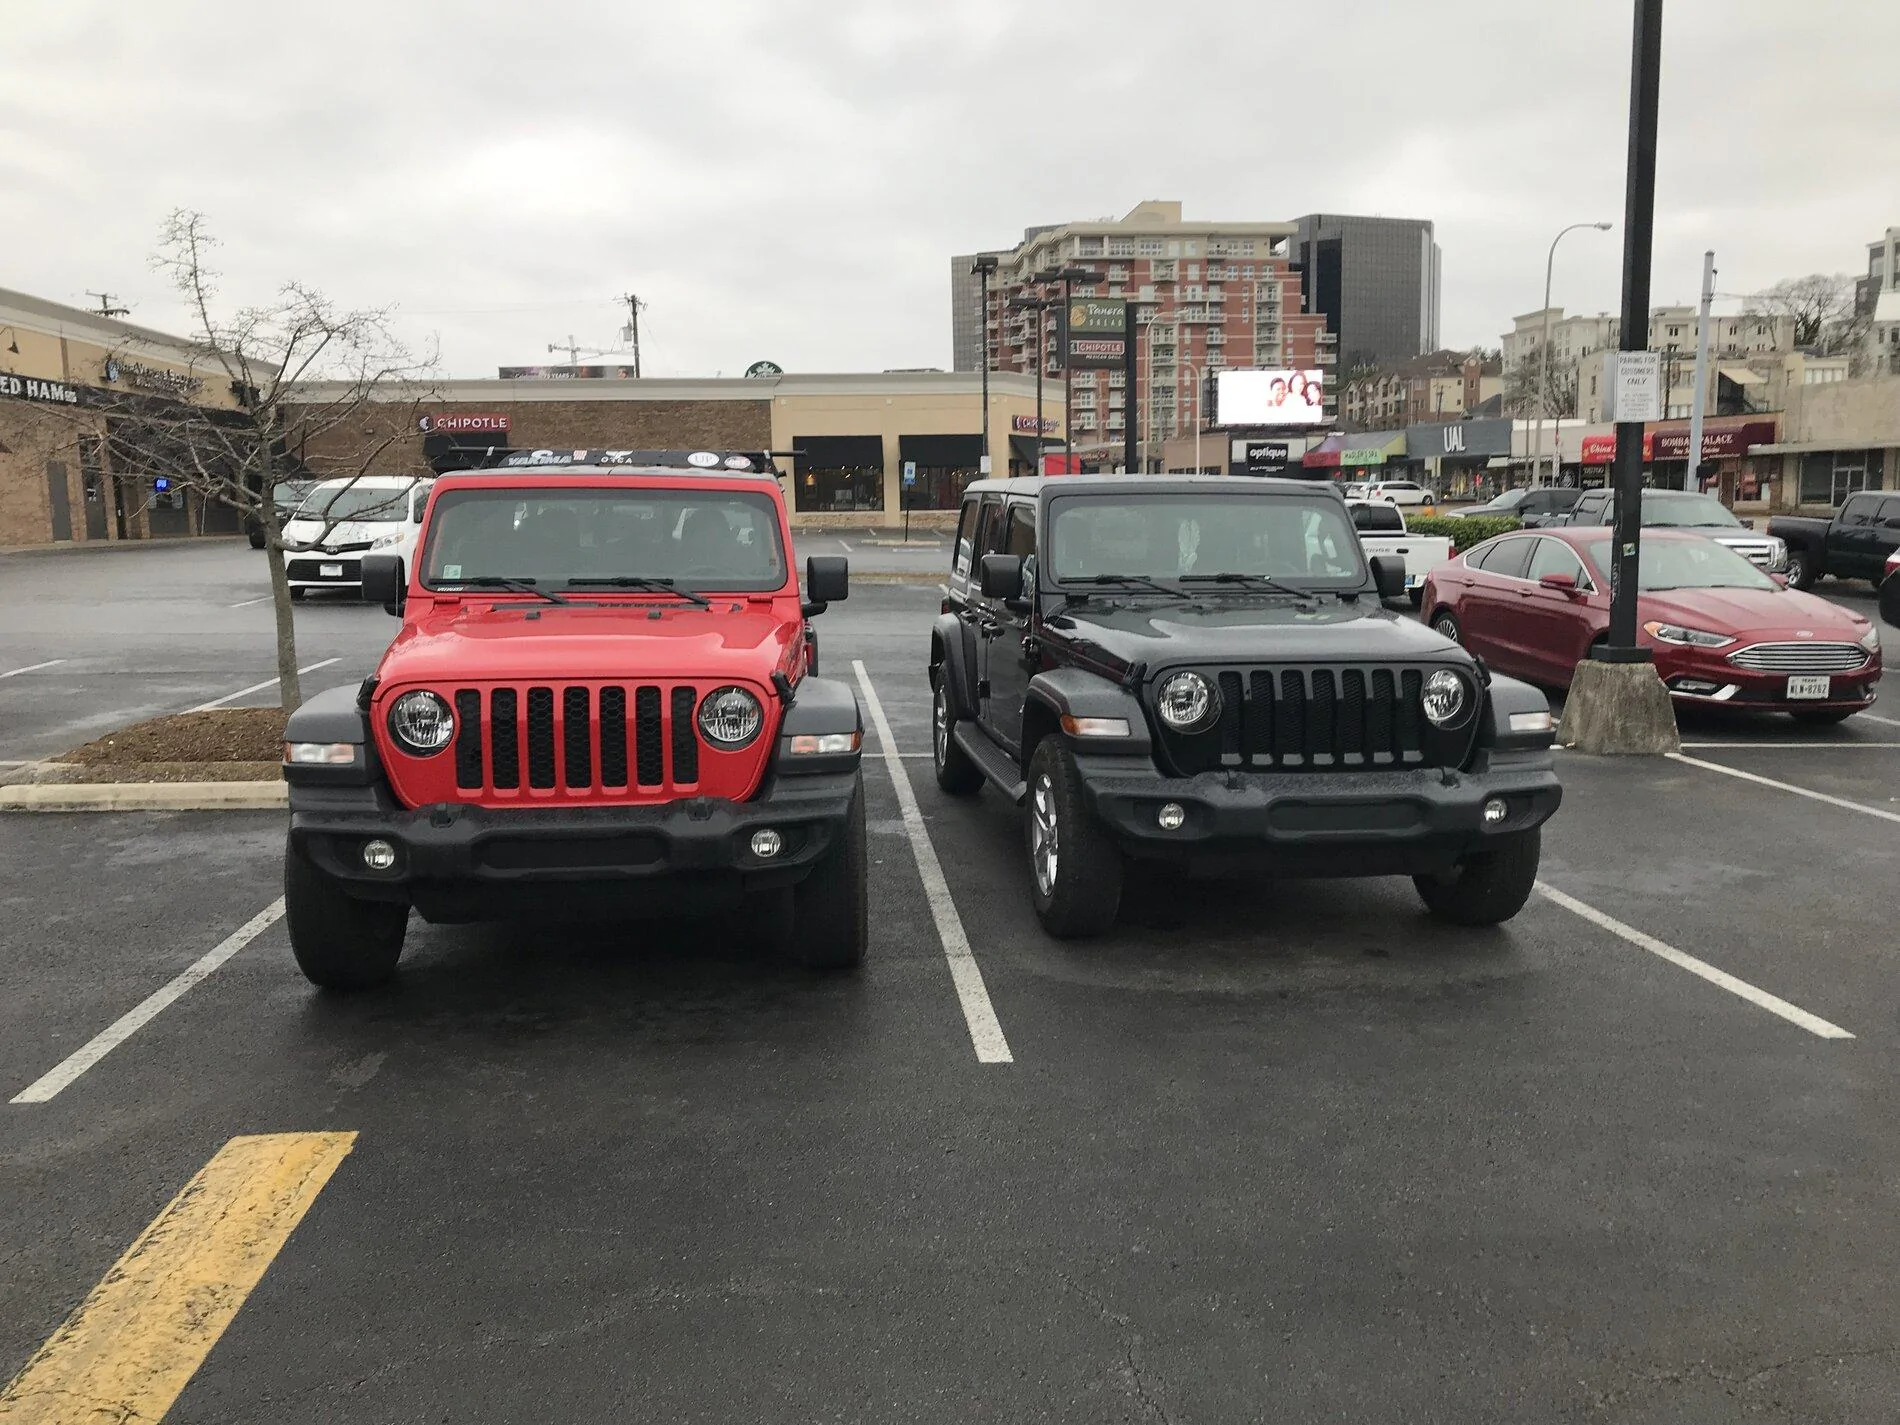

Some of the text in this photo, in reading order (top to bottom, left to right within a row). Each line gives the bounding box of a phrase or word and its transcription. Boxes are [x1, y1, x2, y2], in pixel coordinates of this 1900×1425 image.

[1087, 303, 1124, 316] Panera
[1079, 343, 1121, 352] CHIPOTLE
[26, 379, 64, 401] HAM
[437, 417, 507, 429] CHIPOTLE
[1443, 425, 1466, 452] UAL
[1661, 436, 1691, 448] BOMBA
[1249, 446, 1287, 460] optique
[508, 455, 572, 466] YAKIMA
